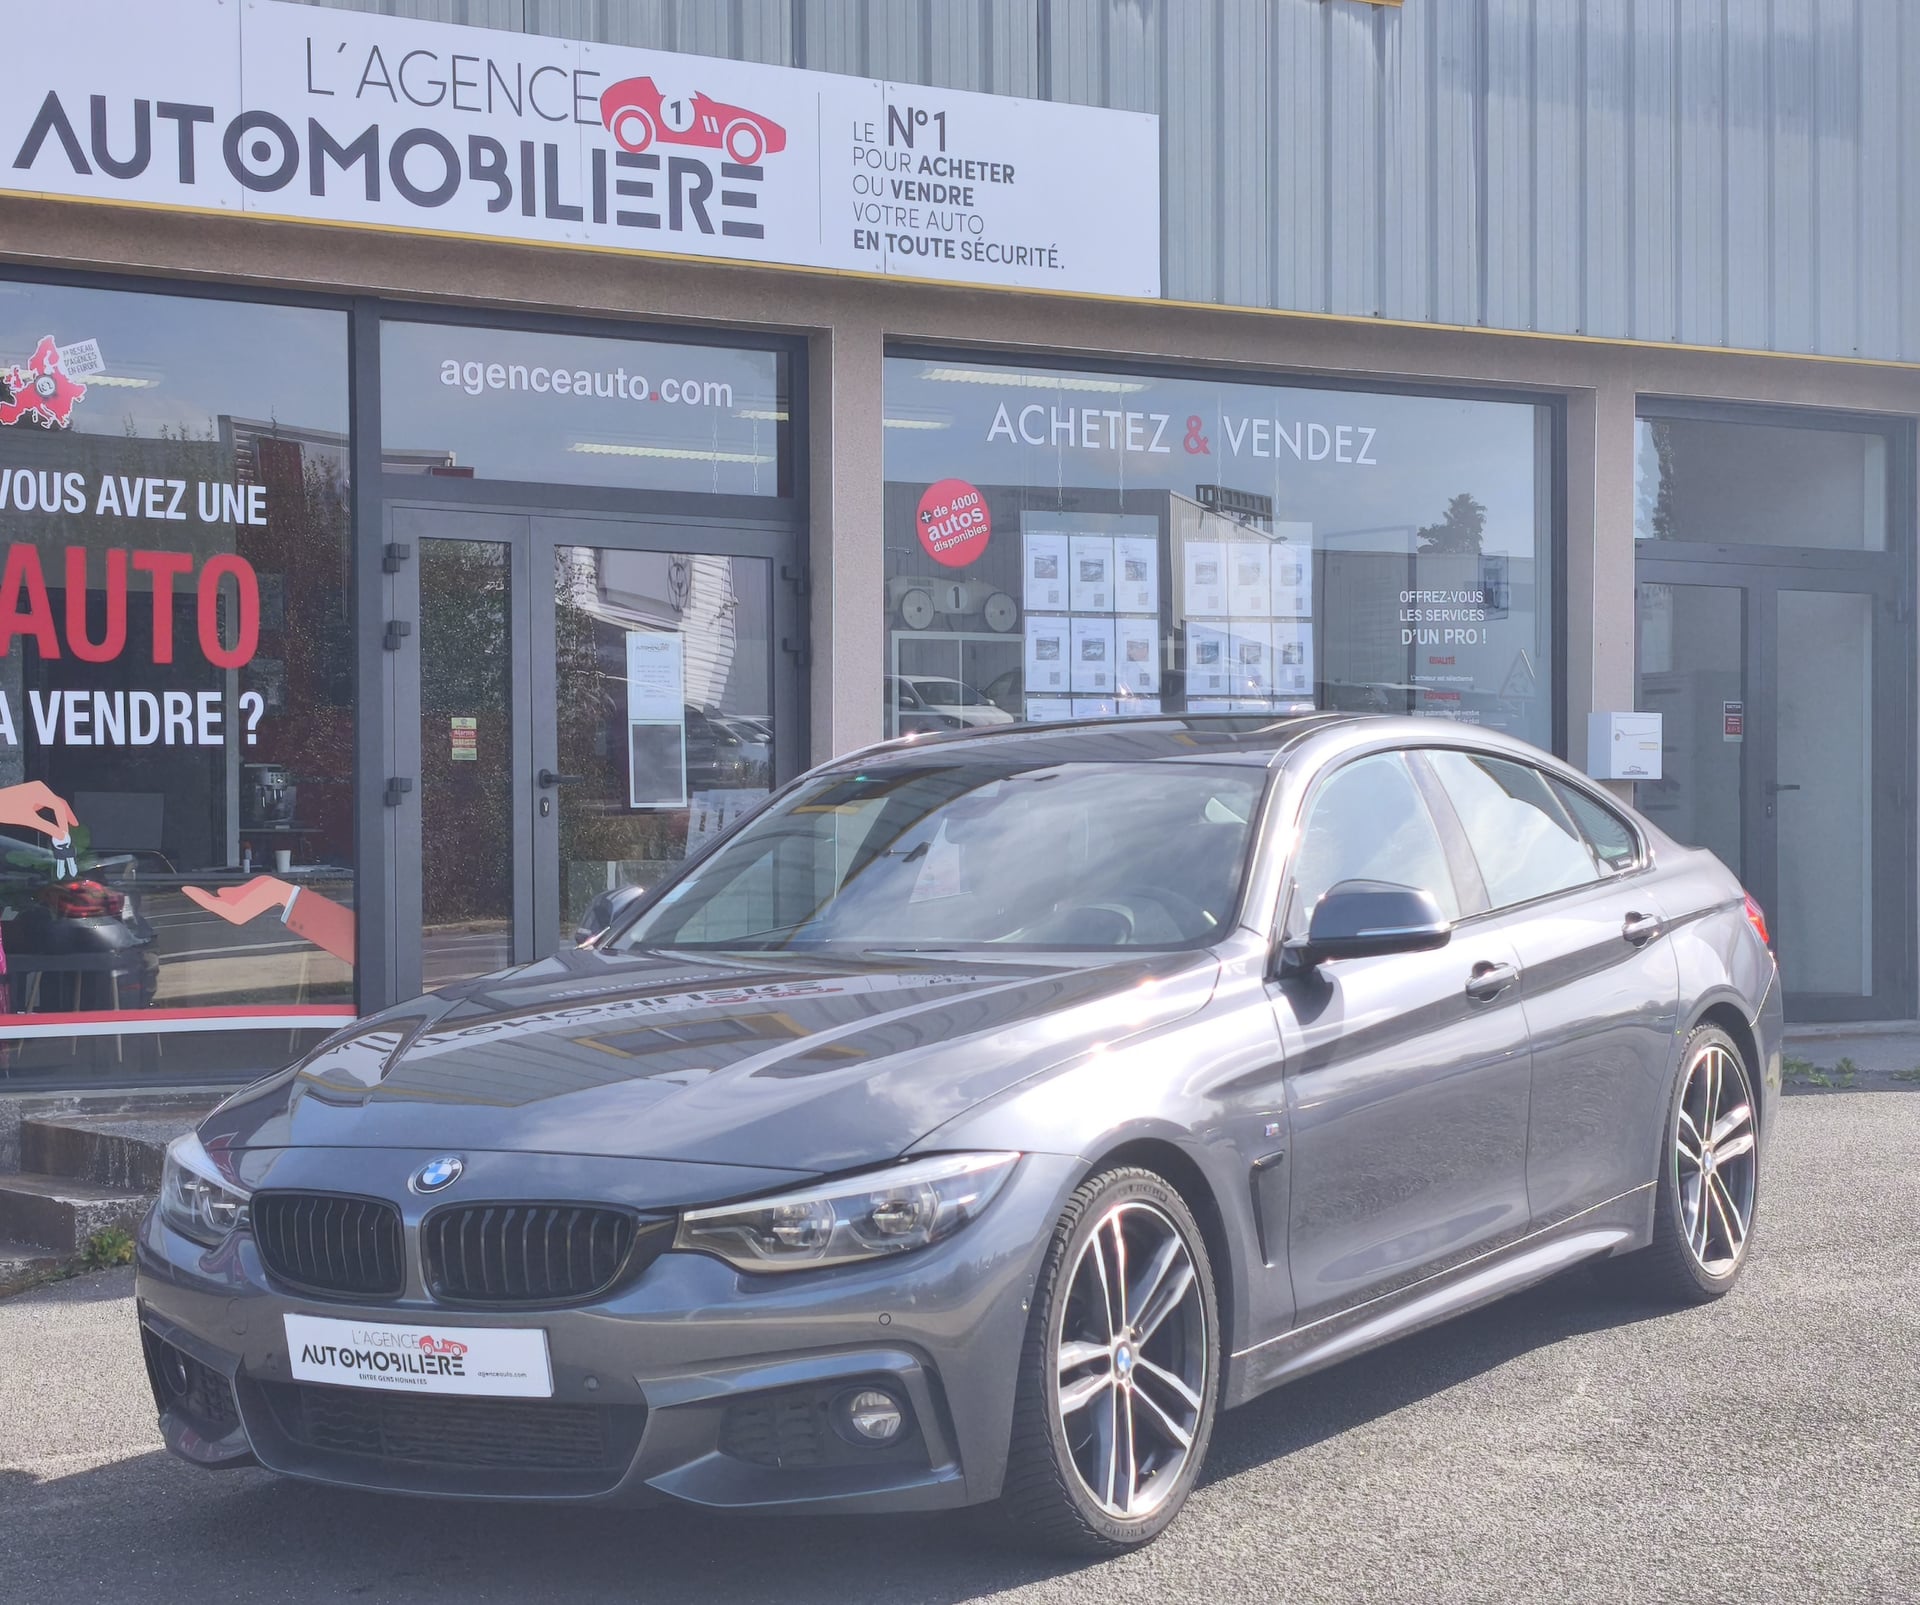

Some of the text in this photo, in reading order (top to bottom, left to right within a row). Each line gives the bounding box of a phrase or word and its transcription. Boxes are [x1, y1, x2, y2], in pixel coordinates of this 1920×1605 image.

[305, 37, 602, 126] L'AGENCE
[853, 121, 875, 143] LE
[12, 90, 764, 239] AUTOMOBILIERE
[853, 147, 1015, 184] POUR ACHETER
[853, 174, 974, 206] OU VENDRE
[853, 201, 984, 234] VOTRE AUTO
[854, 229, 1065, 269] EN TOUTE SÉCURITÉ.
[440, 359, 734, 409] agenceauto.com
[986, 402, 1377, 465] ACHETEZ & VENDEZ
[96, 475, 187, 520] AVEZ
[199, 481, 267, 525] UNE
[934, 505, 948, 518] de
[951, 492, 978, 512] 4000
[927, 507, 984, 542] autos
[933, 523, 988, 552] disponibles
[0, 543, 260, 669] AUTO
[1400, 591, 1484, 603] OFFREZ-VOUS
[1400, 609, 1485, 621] LES SERVICES
[1401, 628, 1439, 645] D'UN
[1444, 628, 1477, 644] PRO
[28, 690, 222, 745] VENDRE
[352, 1329, 420, 1349] L'AGENCE
[301, 1344, 465, 1376] AUTOMOBILIERE
